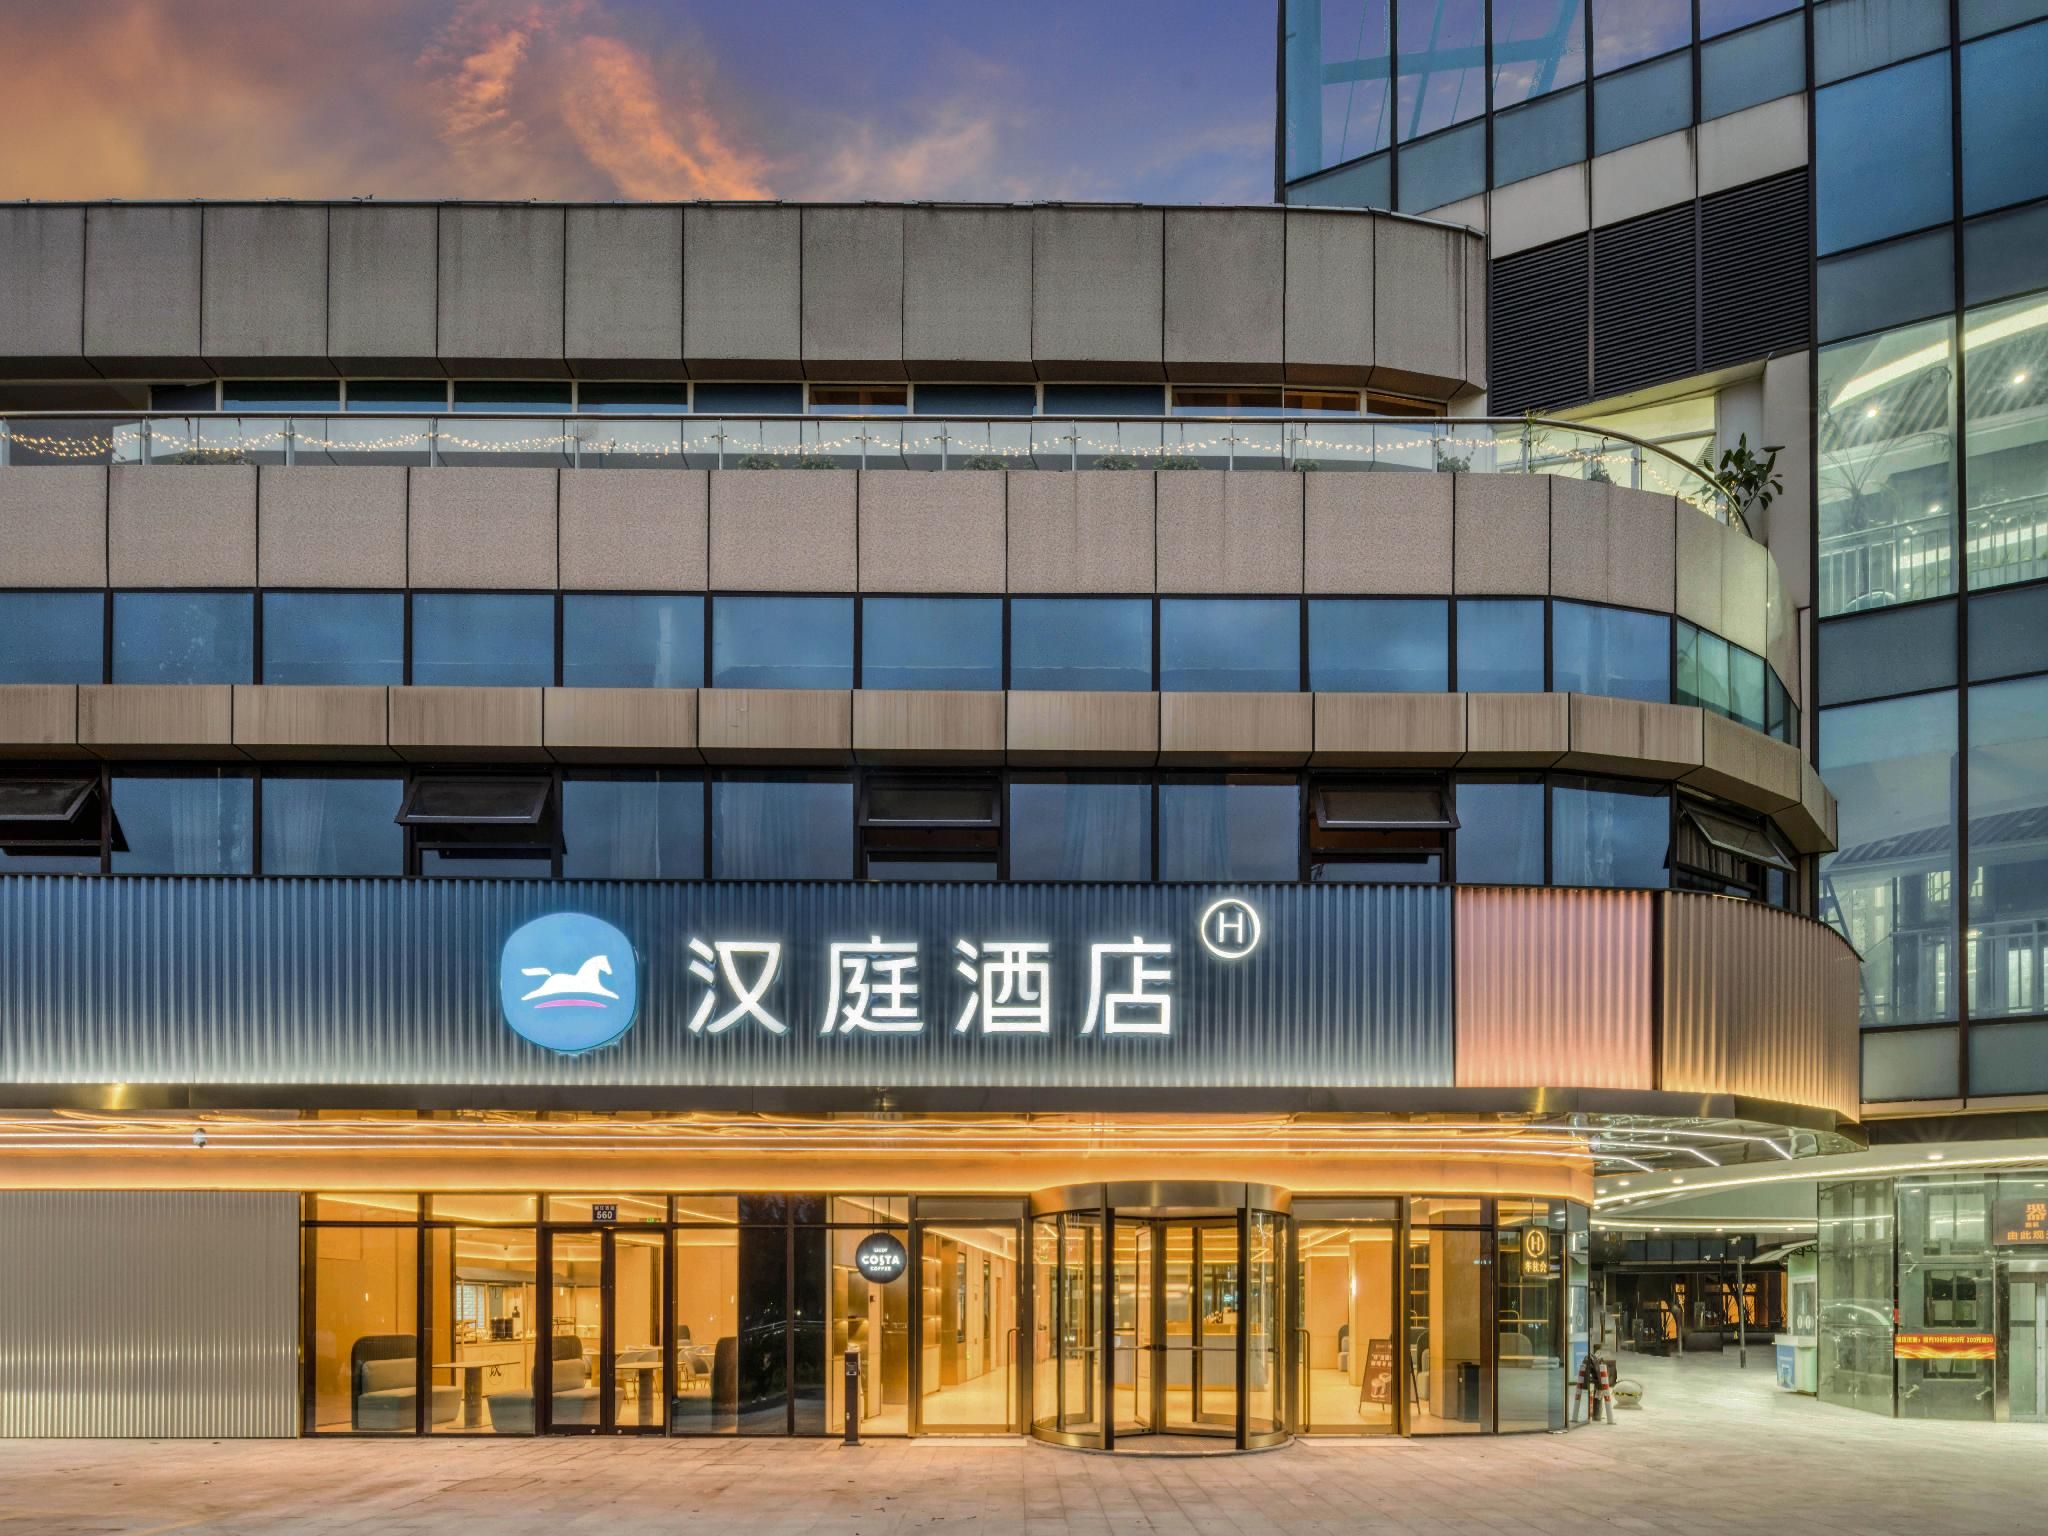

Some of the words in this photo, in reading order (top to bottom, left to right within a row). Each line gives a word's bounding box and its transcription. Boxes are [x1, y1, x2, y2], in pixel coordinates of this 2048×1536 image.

[687, 936, 1174, 1036] 汉庭酒店
[596, 1210, 613, 1220] 560
[2007, 1230, 2048, 1241] 由此观
[861, 1254, 900, 1266] COSTA
